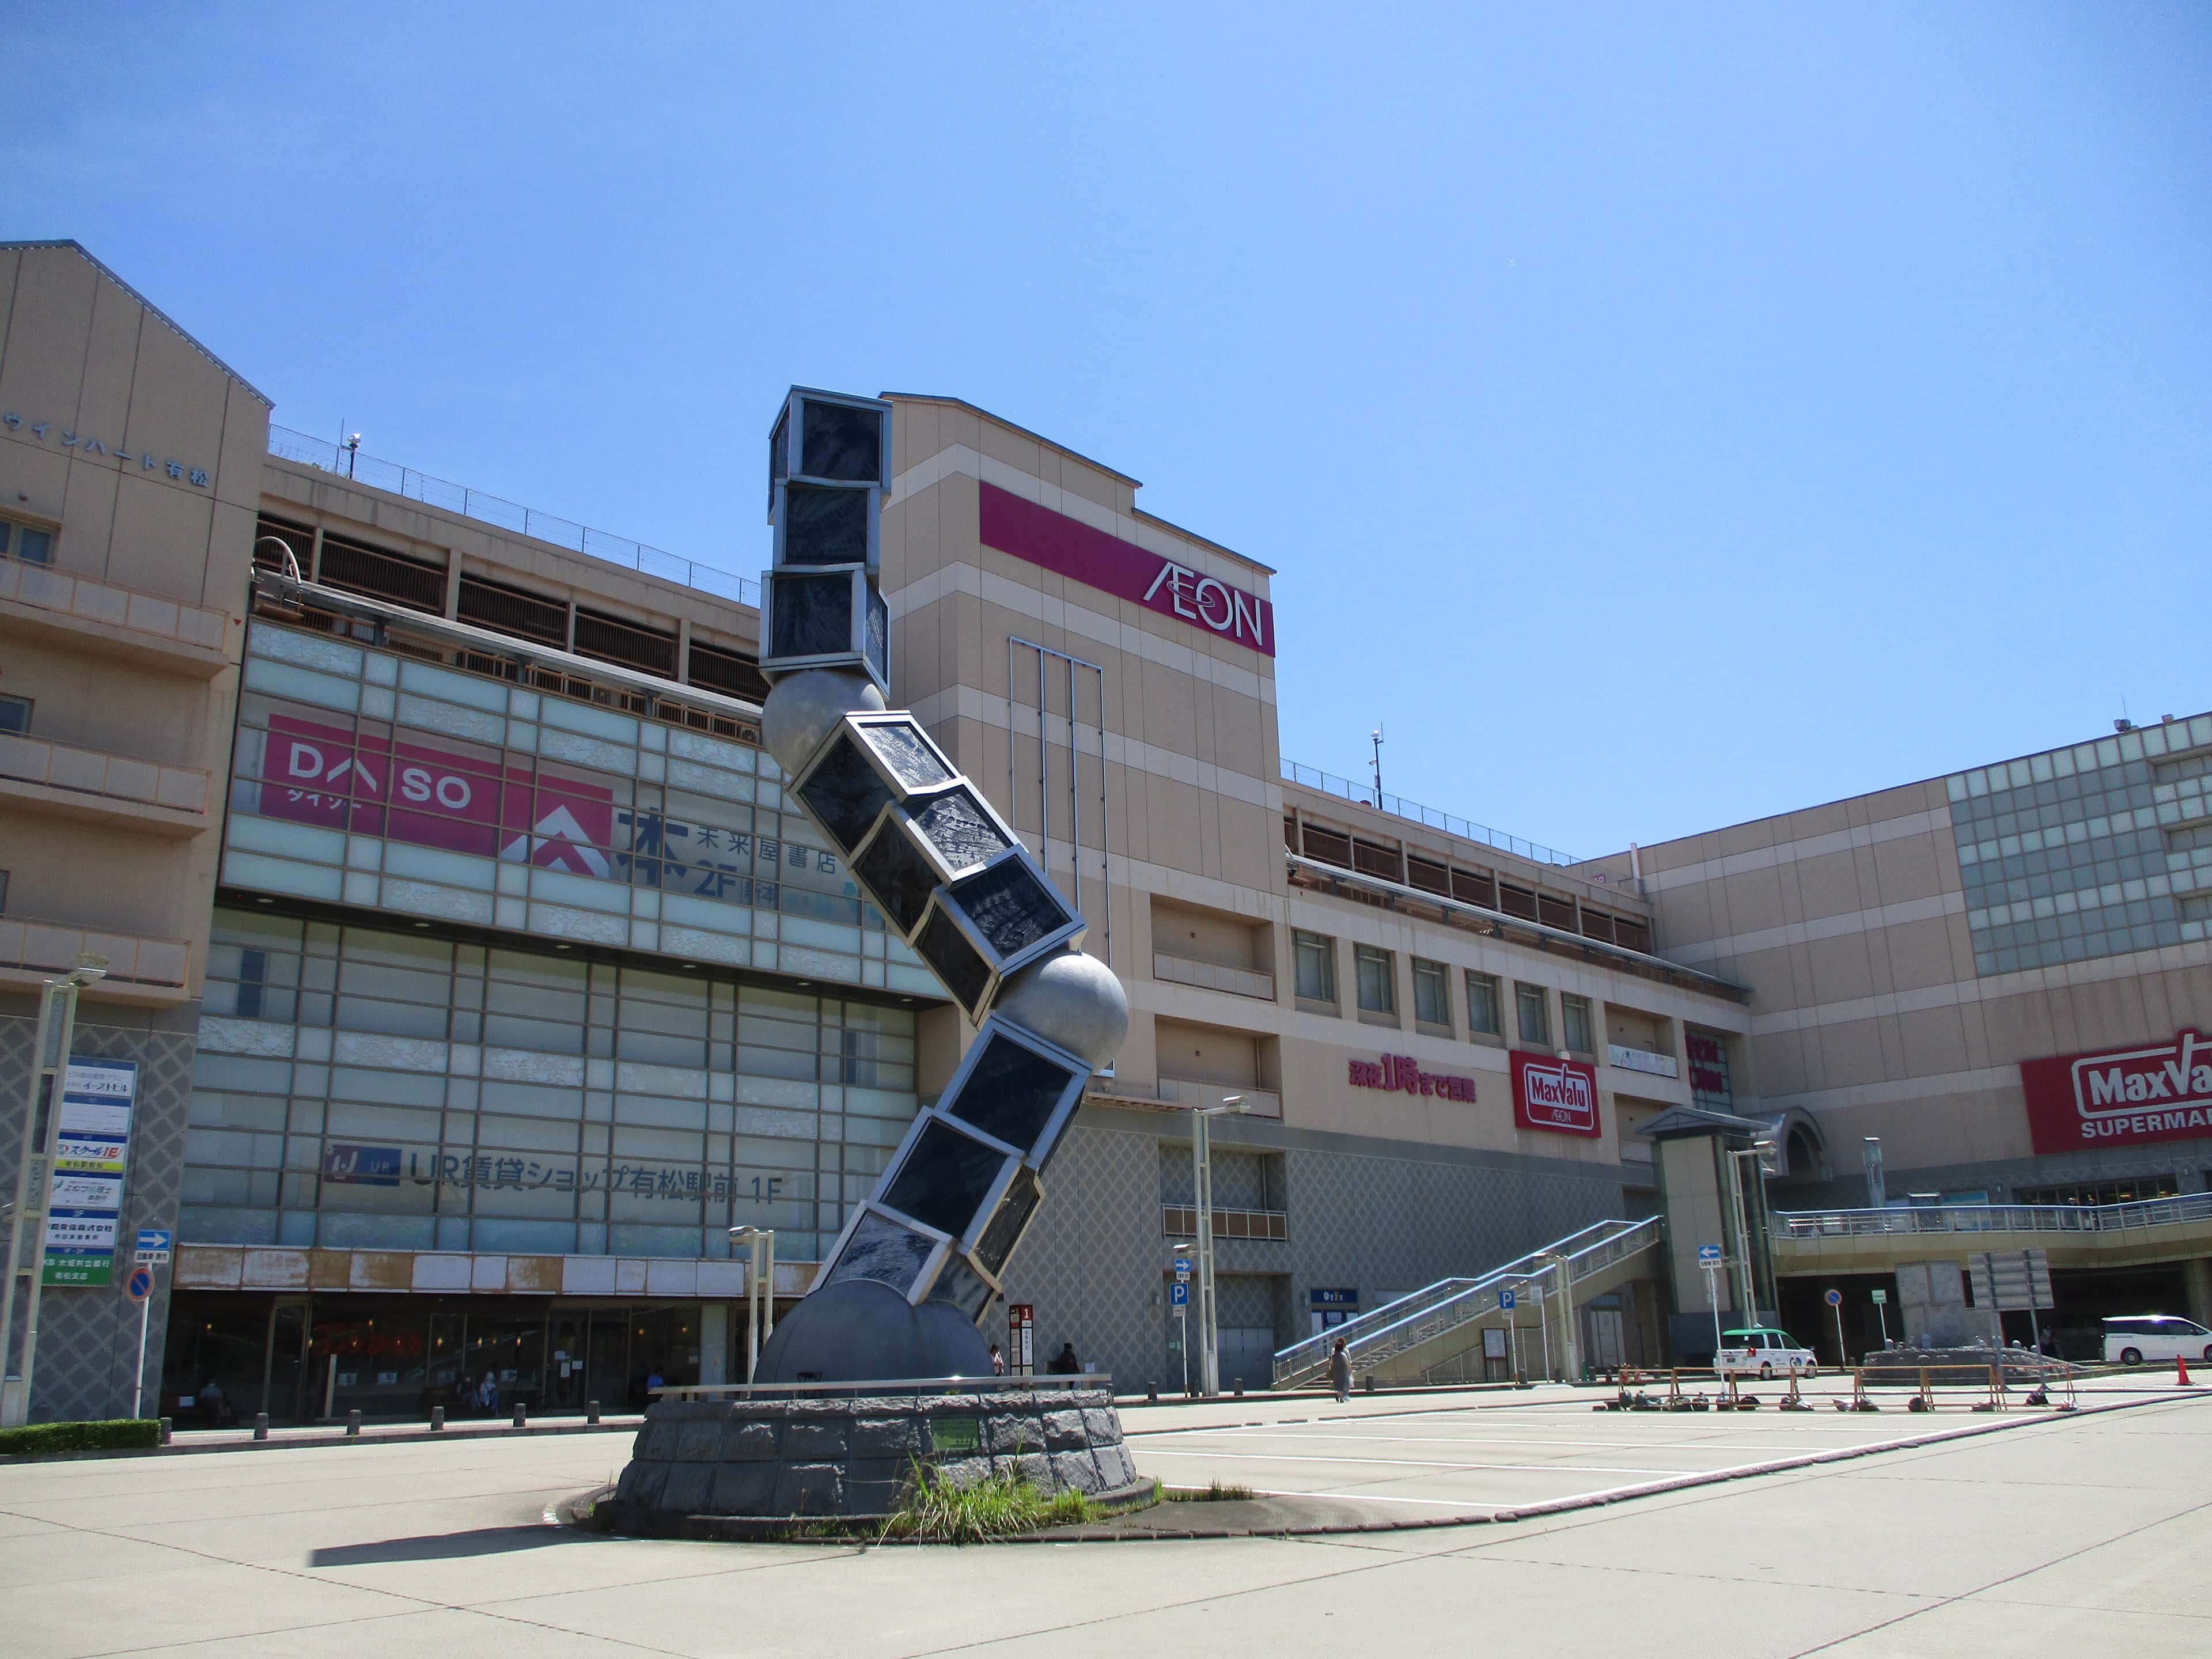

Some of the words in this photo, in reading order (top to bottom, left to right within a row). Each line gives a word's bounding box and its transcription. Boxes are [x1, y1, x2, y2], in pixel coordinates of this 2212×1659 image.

[616, 807, 688, 885] 本
[697, 825, 838, 874] 未来屋書店
[693, 860, 737, 897] 2F
[1349, 1053, 1476, 1103] 深夜1時まで営業
[1531, 1065, 1586, 1107] MaxValu
[2088, 1033, 2212, 1105] MaxVa
[370, 1161, 390, 1172] UR
[1024, 1308, 1029, 1319] 1
[1175, 1285, 1185, 1303] P
[1503, 1292, 1512, 1307] P
